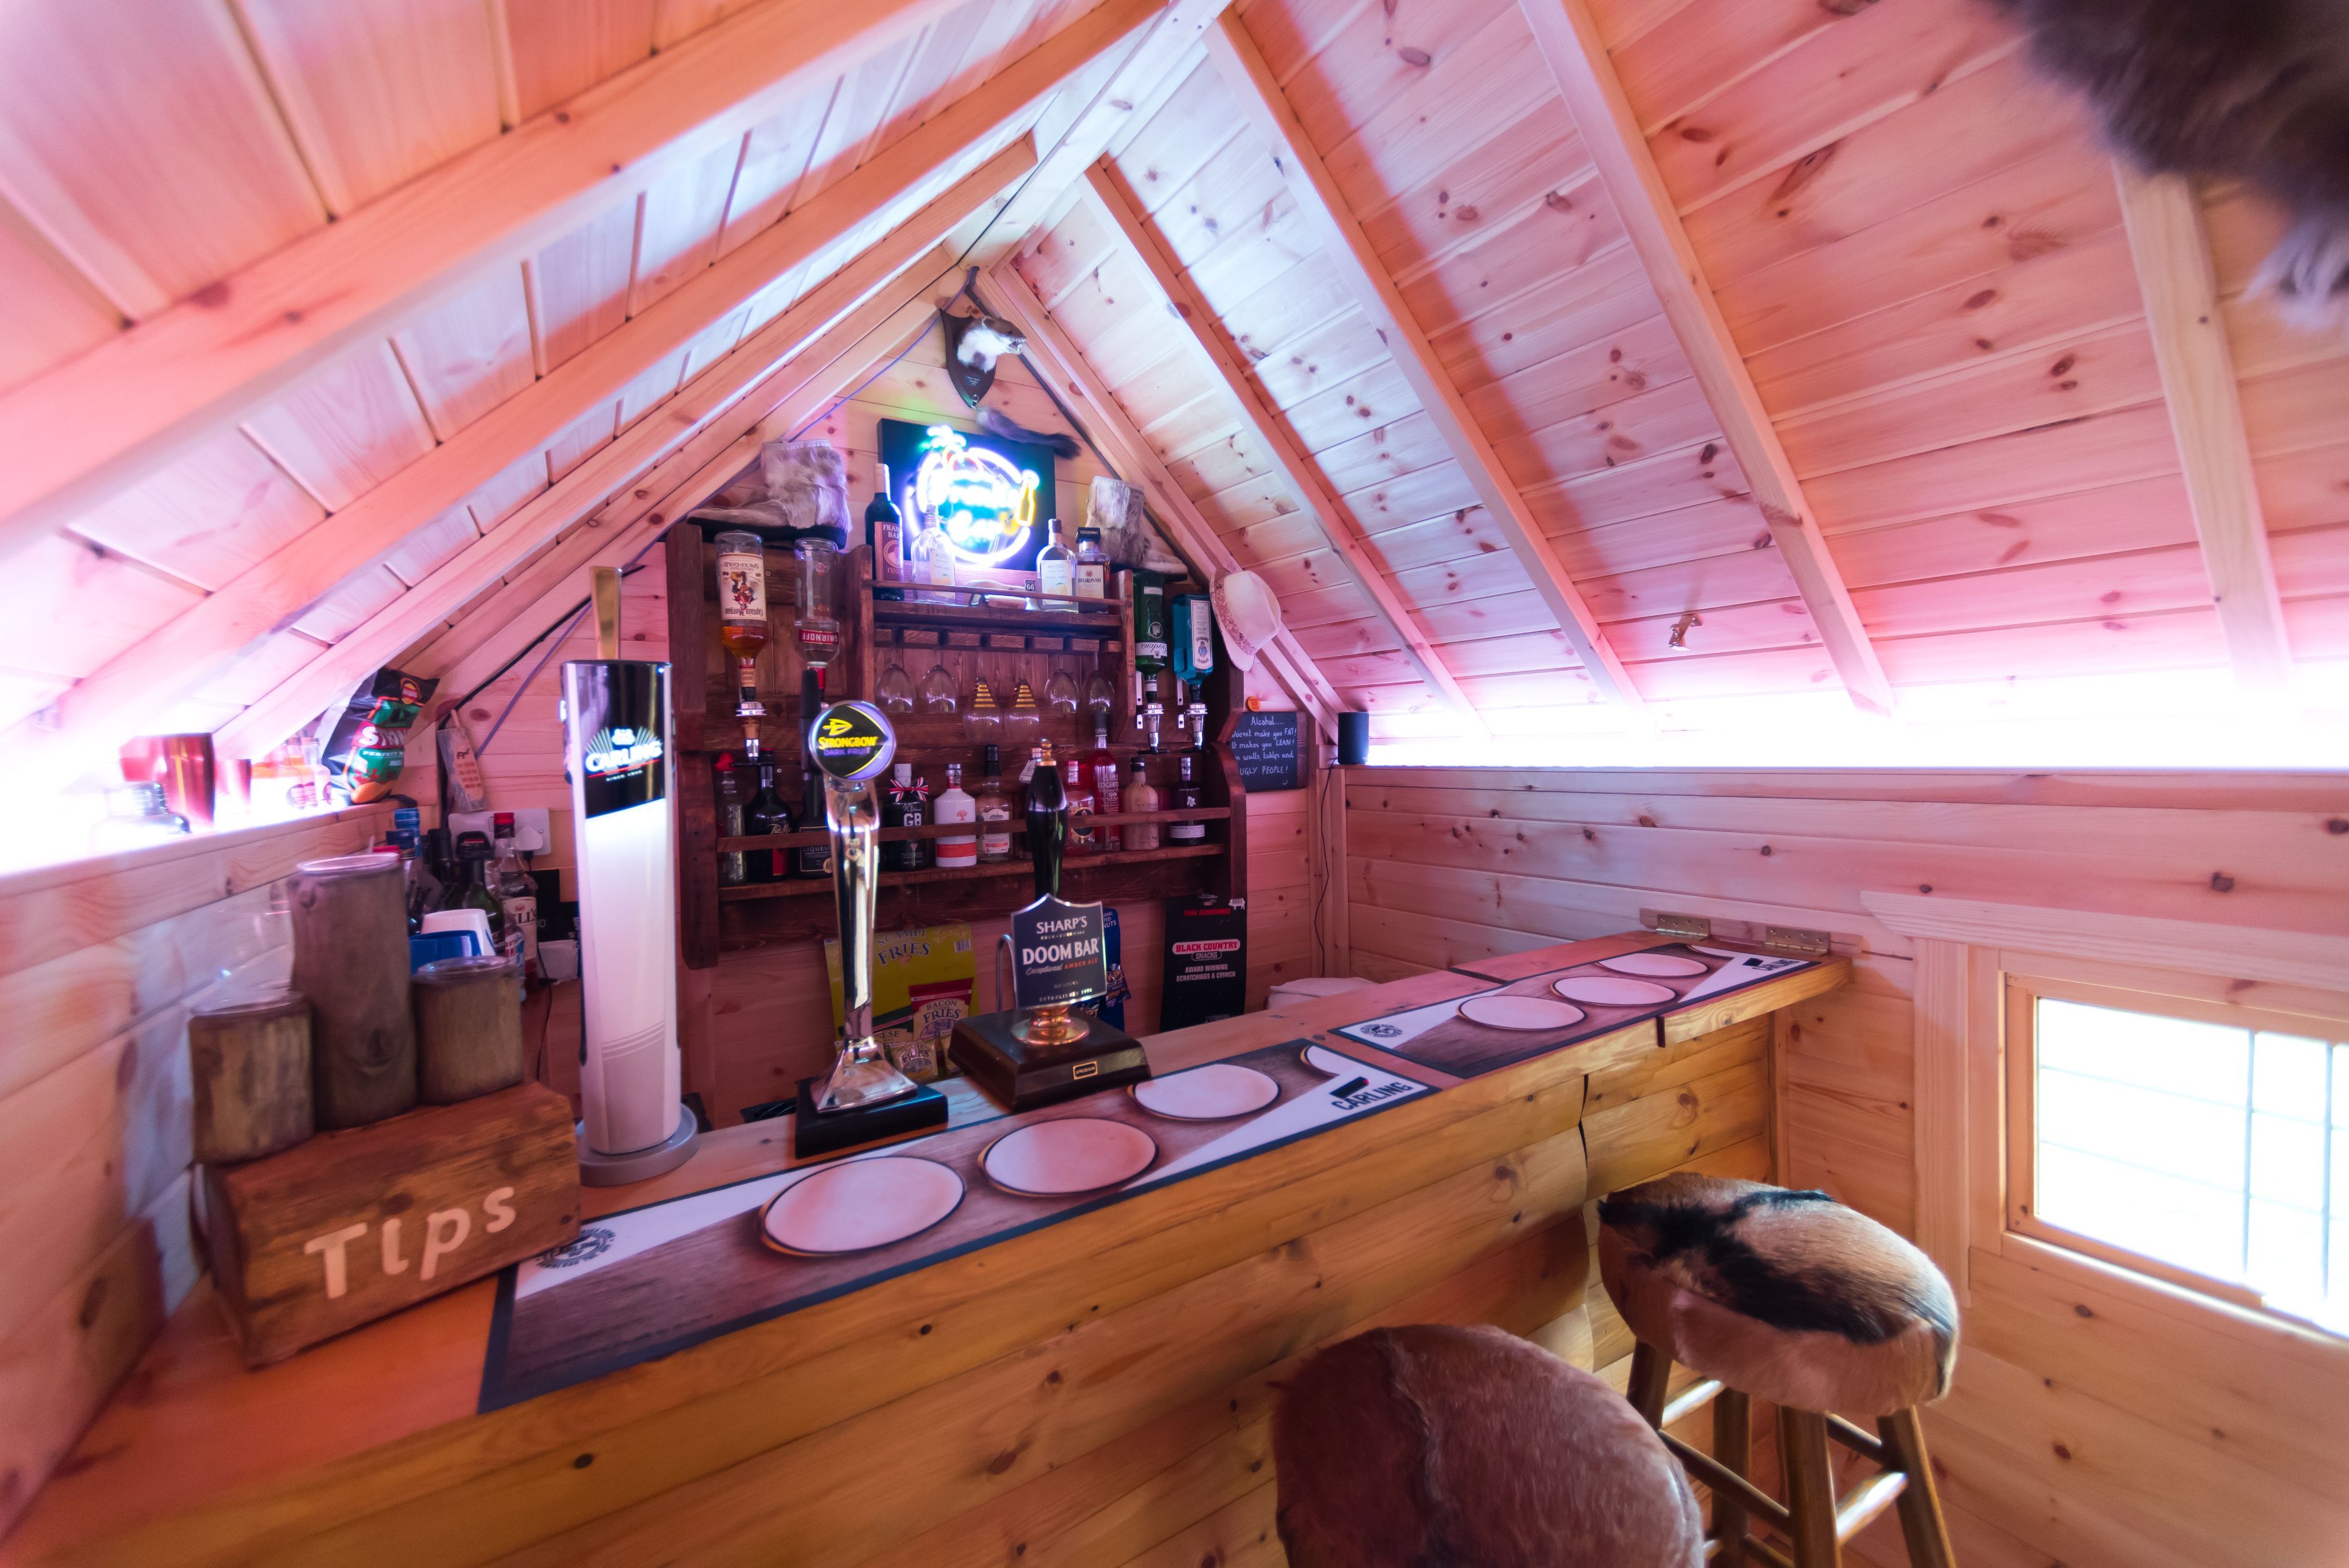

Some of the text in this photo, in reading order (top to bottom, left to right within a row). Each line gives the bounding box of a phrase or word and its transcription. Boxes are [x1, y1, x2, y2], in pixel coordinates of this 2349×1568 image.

[724, 607, 763, 617] Captain Morgan
[801, 632, 838, 642] SMIRNOFF
[1273, 732, 1283, 740] you
[1284, 728, 1296, 736] FAT!
[818, 736, 878, 750] STRONGBOW
[1239, 740, 1259, 749] makes
[1261, 743, 1272, 751] you
[585, 740, 663, 771] CARLING
[823, 747, 871, 756] DARK FRUIT
[1263, 750, 1280, 760] tables
[1281, 750, 1294, 758] and
[1239, 766, 1258, 776] UGLY
[903, 812, 922, 827] GB
[768, 824, 782, 835] Tia
[1036, 916, 1088, 934] SHARP'S
[878, 928, 926, 945] SCAMPI
[1022, 938, 1100, 965] DOOM BAR
[1175, 941, 1238, 953] BLACK COUNTRY
[878, 942, 931, 965] FRIES
[1196, 951, 1217, 960] SNACKS
[1026, 963, 1063, 976] Exceptional
[1064, 960, 1086, 970] AMBER
[1185, 963, 1229, 973] AWARD WINNING
[1751, 959, 1801, 971] CARLING
[1176, 973, 1211, 982] SCRATCHINGS
[1216, 971, 1236, 979] CRUNCH
[926, 999, 958, 1011] BACON
[923, 1009, 962, 1024] FRIES
[1331, 1081, 1414, 1110] CARLING
[304, 1185, 517, 1301] Tips
